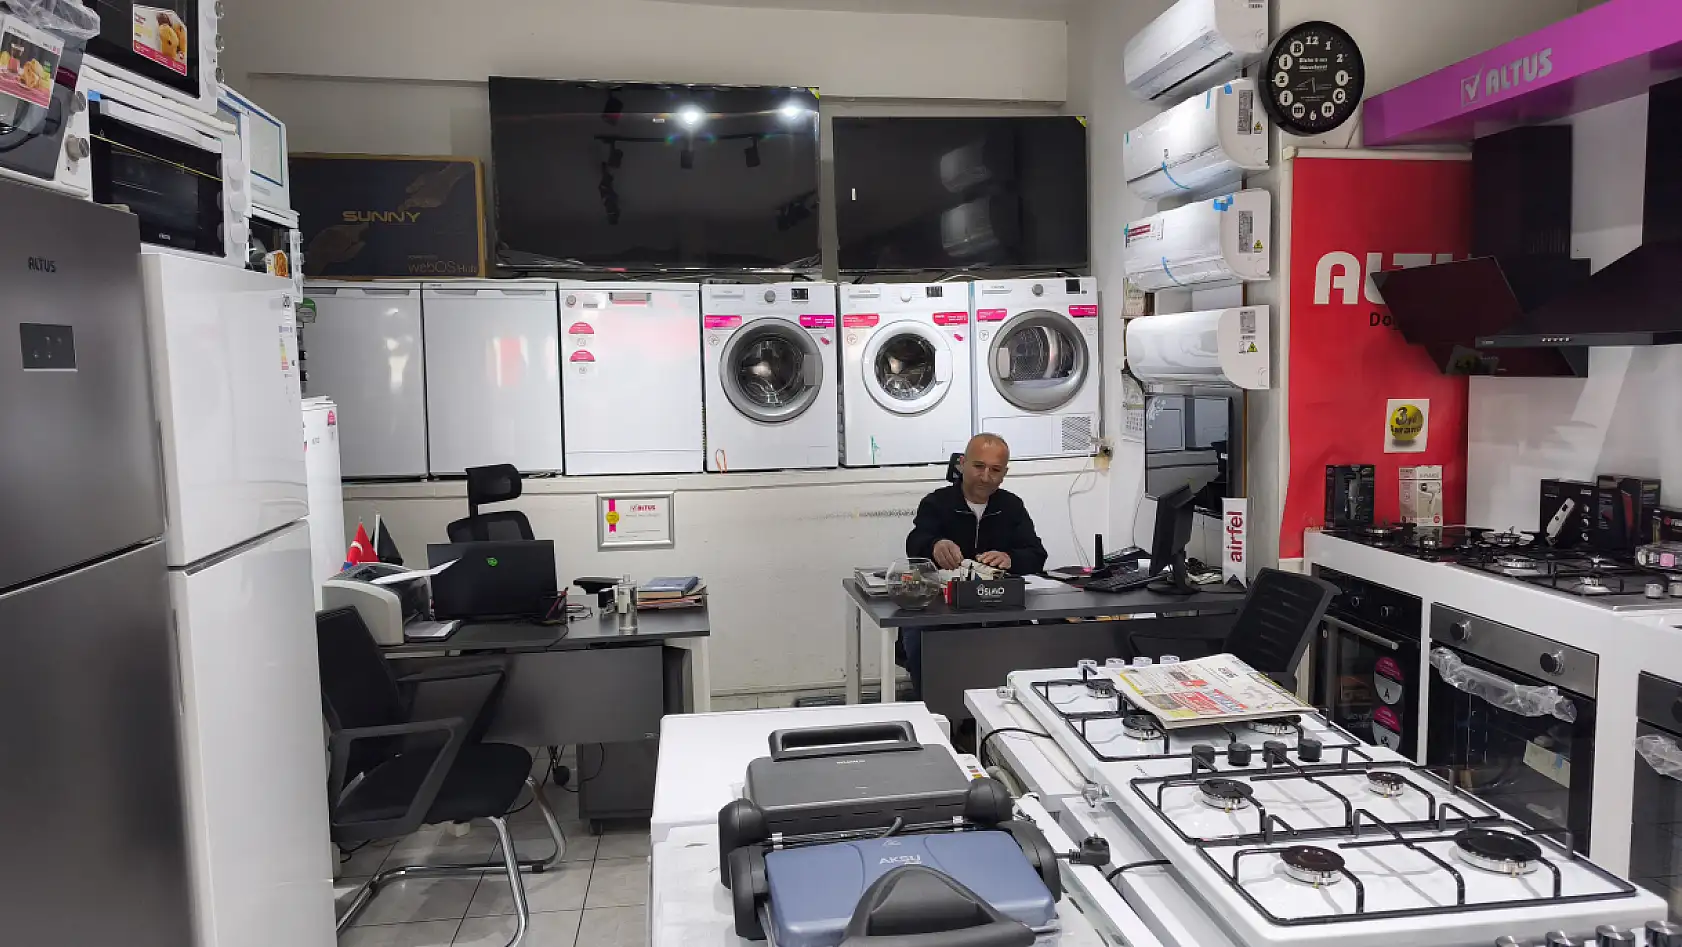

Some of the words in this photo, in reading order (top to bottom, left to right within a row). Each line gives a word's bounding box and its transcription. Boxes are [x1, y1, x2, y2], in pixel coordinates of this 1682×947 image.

[1305, 36, 1319, 45] 12
[1336, 53, 1343, 63] 2
[1485, 48, 1553, 97] ALTUS
[342, 210, 421, 223] SUNNY
[28, 256, 57, 273] ALTUS
[1395, 406, 1408, 426] 3
[1226, 511, 1243, 563] airfel
[879, 855, 921, 865] AKSU
